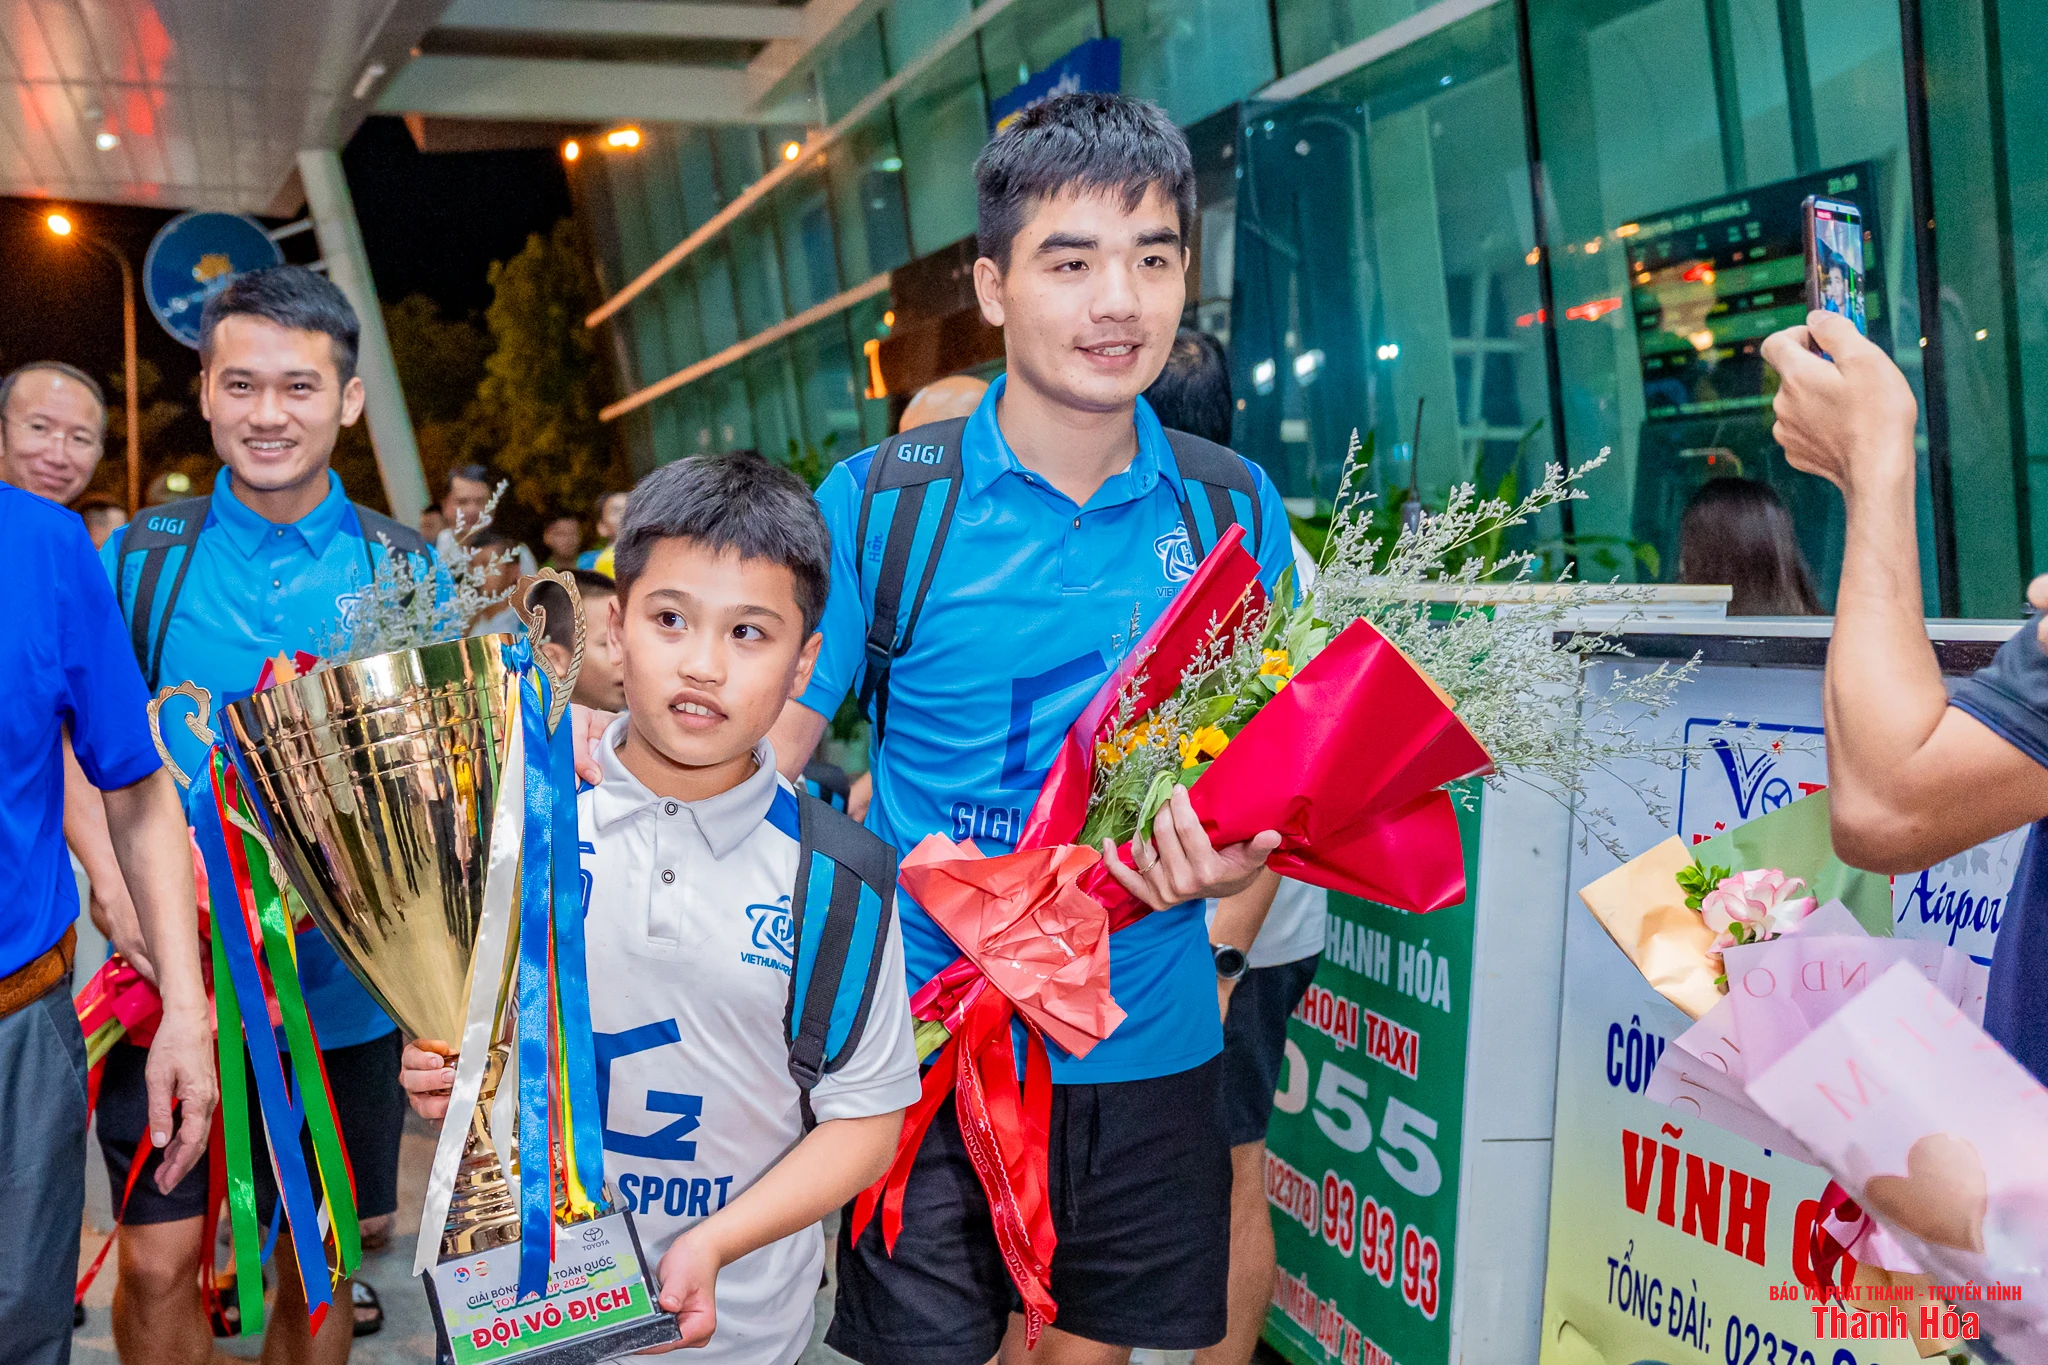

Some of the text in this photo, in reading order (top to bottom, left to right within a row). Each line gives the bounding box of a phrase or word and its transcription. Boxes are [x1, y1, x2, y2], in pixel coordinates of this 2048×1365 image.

[898, 444, 944, 465] GIGI
[147, 515, 186, 535] GIGI
[1157, 586, 1183, 598] VIET
[951, 802, 1021, 844] GIGI
[1897, 869, 2002, 947] Airpor
[1325, 913, 1451, 1014] HANH HÓA
[1292, 984, 1419, 1081] HOẠI TAXI
[1606, 1013, 1665, 1096] CÔN
[963, 1119, 989, 1173] CHANEL
[618, 1171, 734, 1218] SPORT
[1621, 1122, 1771, 1268] VĨNH
[553, 1265, 582, 1280] TOÀN
[584, 1255, 614, 1272] QUỐC
[581, 1238, 611, 1252] TOYOTA
[1322, 1168, 1357, 1258] 93
[1360, 1194, 1397, 1289] 93
[1401, 1223, 1441, 1322] 93
[546, 1282, 560, 1294] UP
[563, 1274, 587, 1289] 2025
[1607, 1239, 1663, 1327] TỔNG
[1668, 1278, 1712, 1354] ĐÀI:
[472, 1285, 633, 1349] ĐỘI VÔ ĐỊCH
